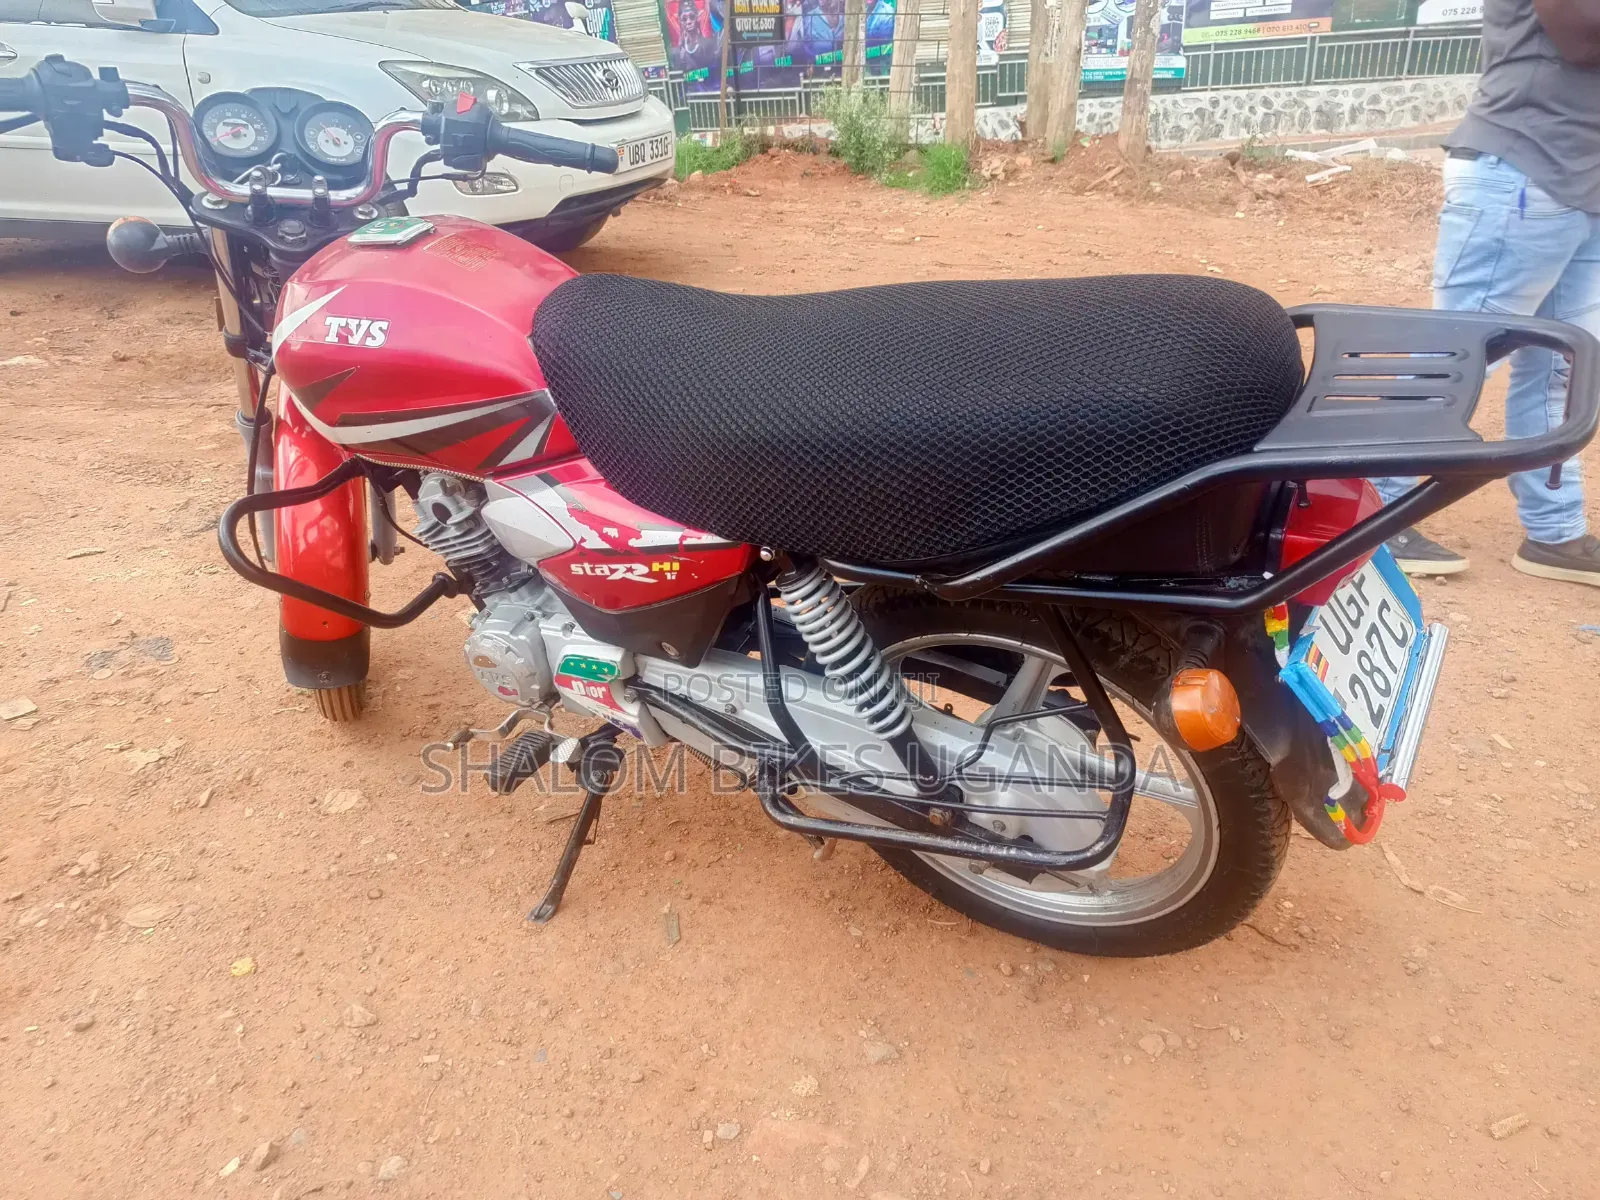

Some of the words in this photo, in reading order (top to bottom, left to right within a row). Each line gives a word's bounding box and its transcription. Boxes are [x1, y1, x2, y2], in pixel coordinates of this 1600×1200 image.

[1442, 8, 1458, 16] 075
[1460, 6, 1476, 15] 228
[1229, 28, 1242, 36] 228
[628, 142, 646, 166] UBQ
[649, 136, 669, 160] 331G
[324, 316, 389, 347] TVS
[1350, 598, 1409, 729] 287C
